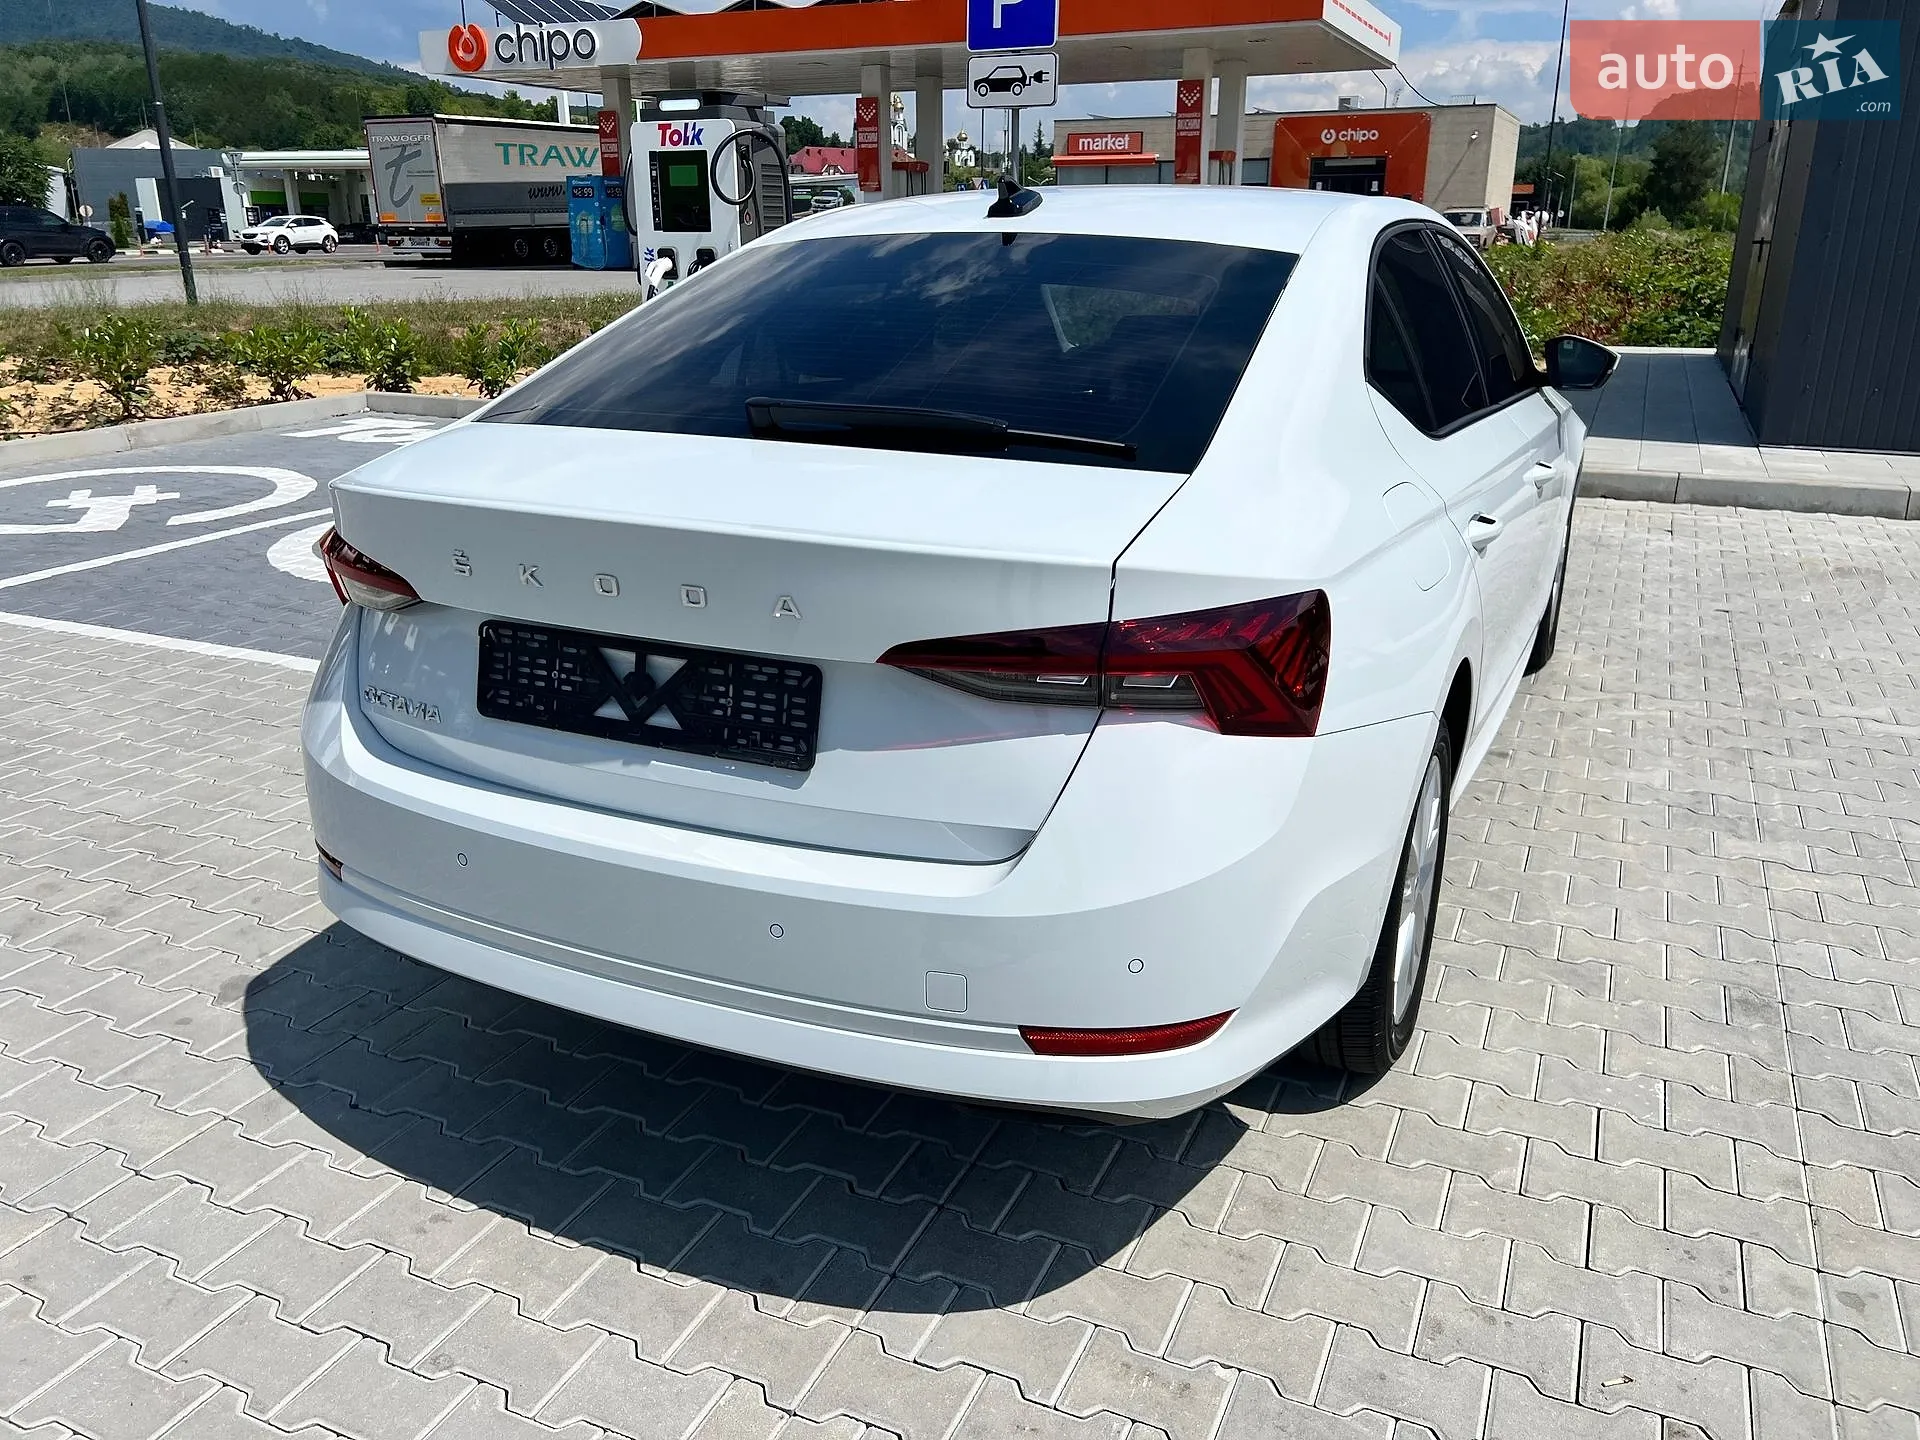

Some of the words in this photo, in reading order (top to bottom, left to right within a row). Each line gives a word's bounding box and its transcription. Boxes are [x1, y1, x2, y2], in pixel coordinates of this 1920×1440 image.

[494, 21, 597, 71] chipo
[658, 122, 704, 146] Tolk
[1078, 134, 1130, 151] market
[1338, 127, 1380, 143] chipo
[364, 684, 442, 724] OCTAVIA
